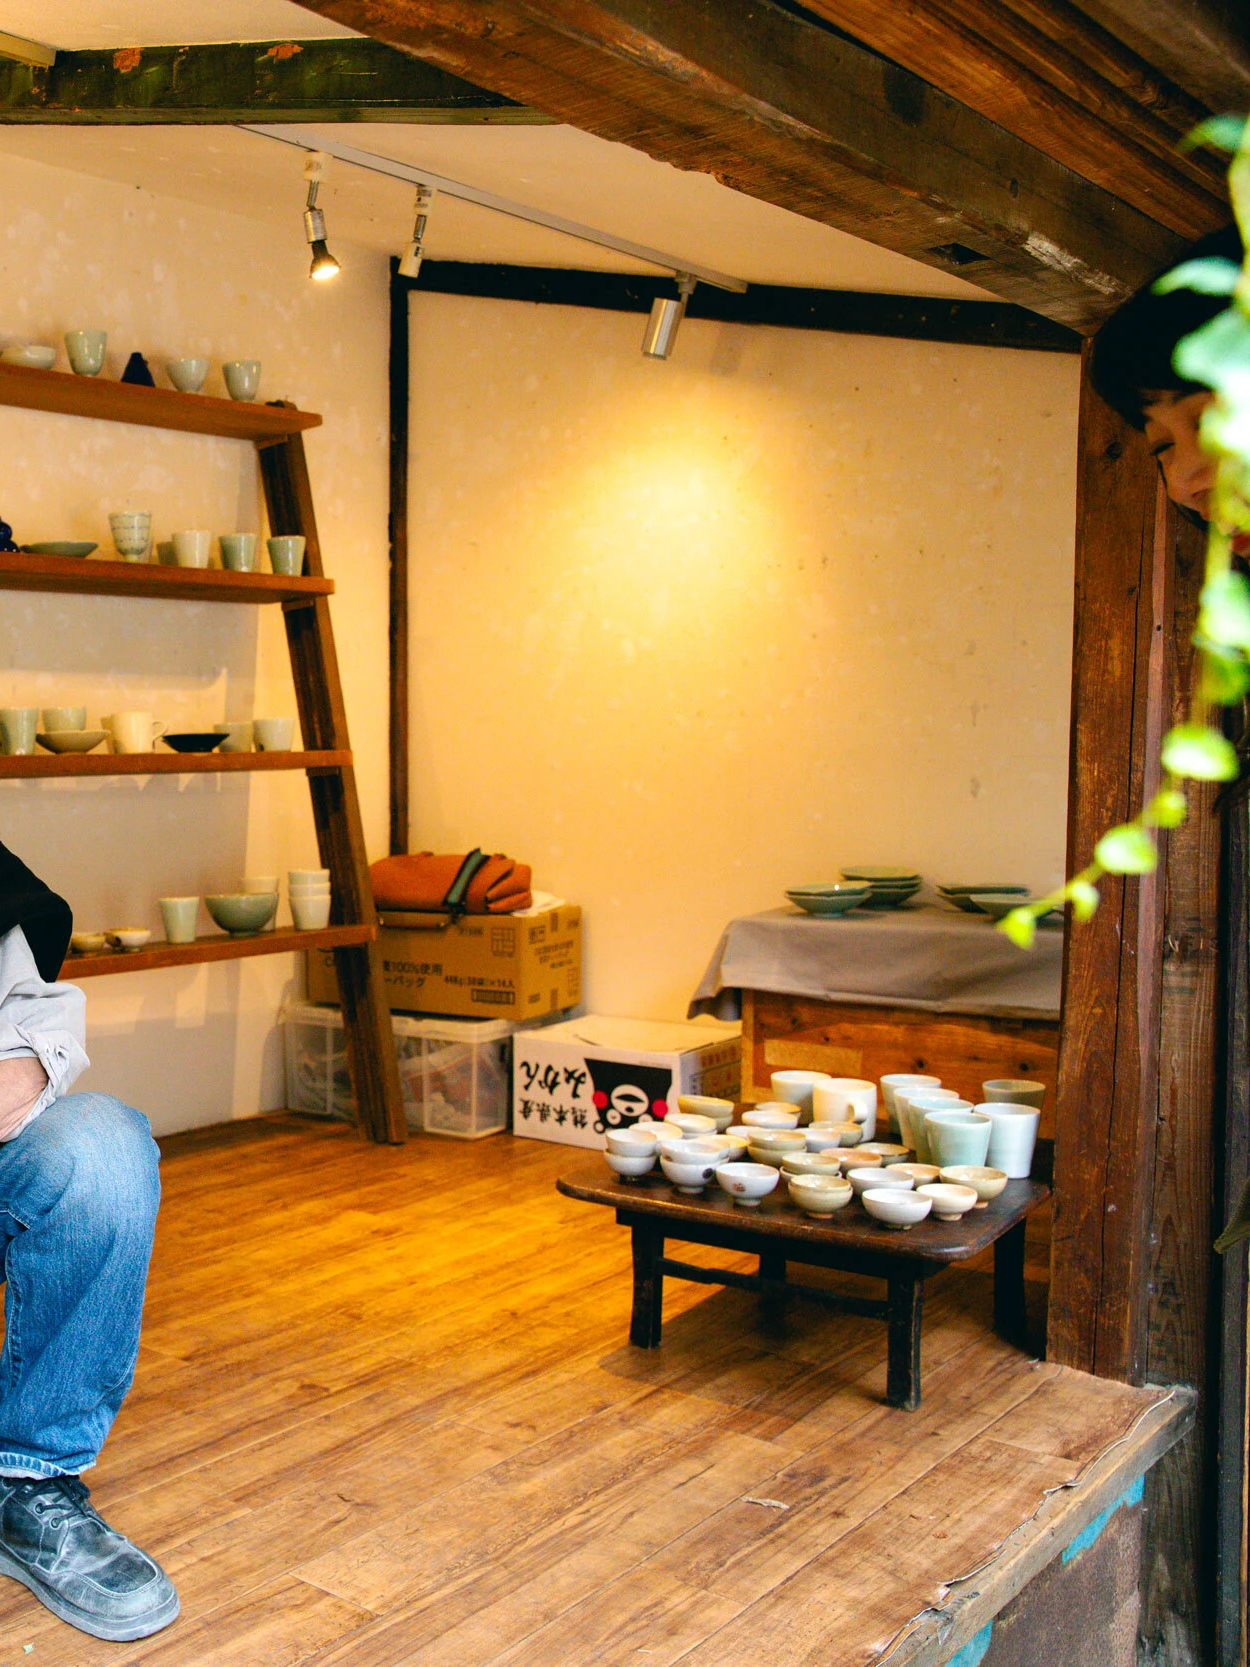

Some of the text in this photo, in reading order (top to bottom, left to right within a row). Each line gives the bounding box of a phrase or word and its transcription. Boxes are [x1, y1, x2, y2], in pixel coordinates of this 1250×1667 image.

[519, 1060, 587, 1099] みかん
[519, 1098, 588, 1129] 熊本県産
